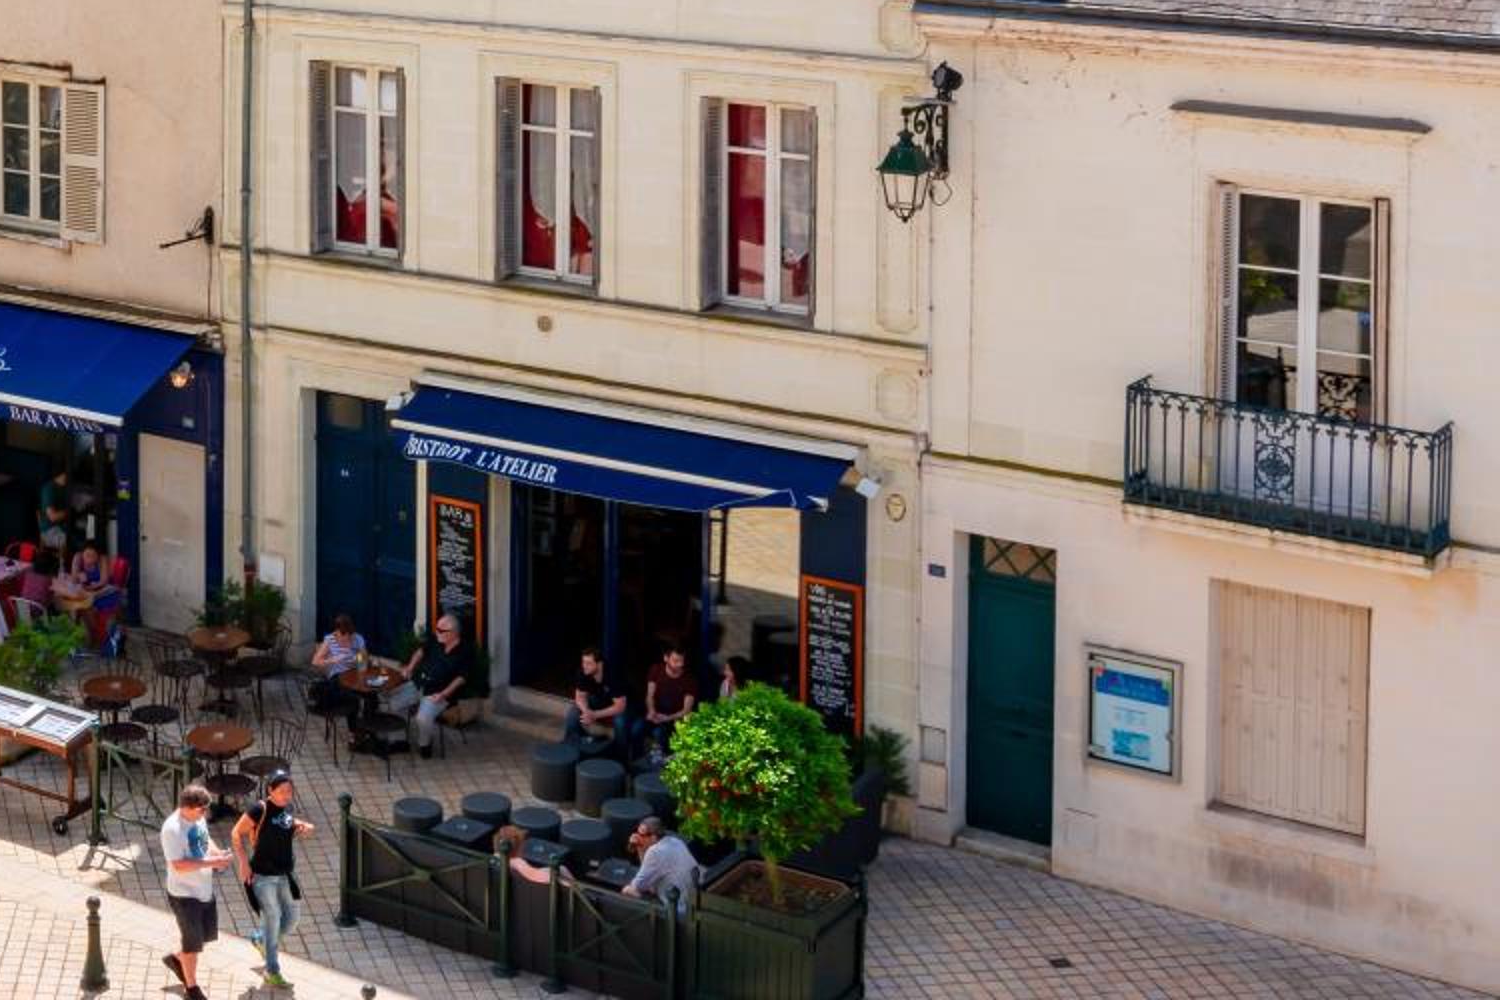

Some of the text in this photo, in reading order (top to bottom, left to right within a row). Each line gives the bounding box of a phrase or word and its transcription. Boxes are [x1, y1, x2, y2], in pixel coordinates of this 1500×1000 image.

[9, 406, 42, 425] BAR
[58, 416, 104, 433] VINS
[407, 435, 558, 483] BISTROT L'ATELIER
